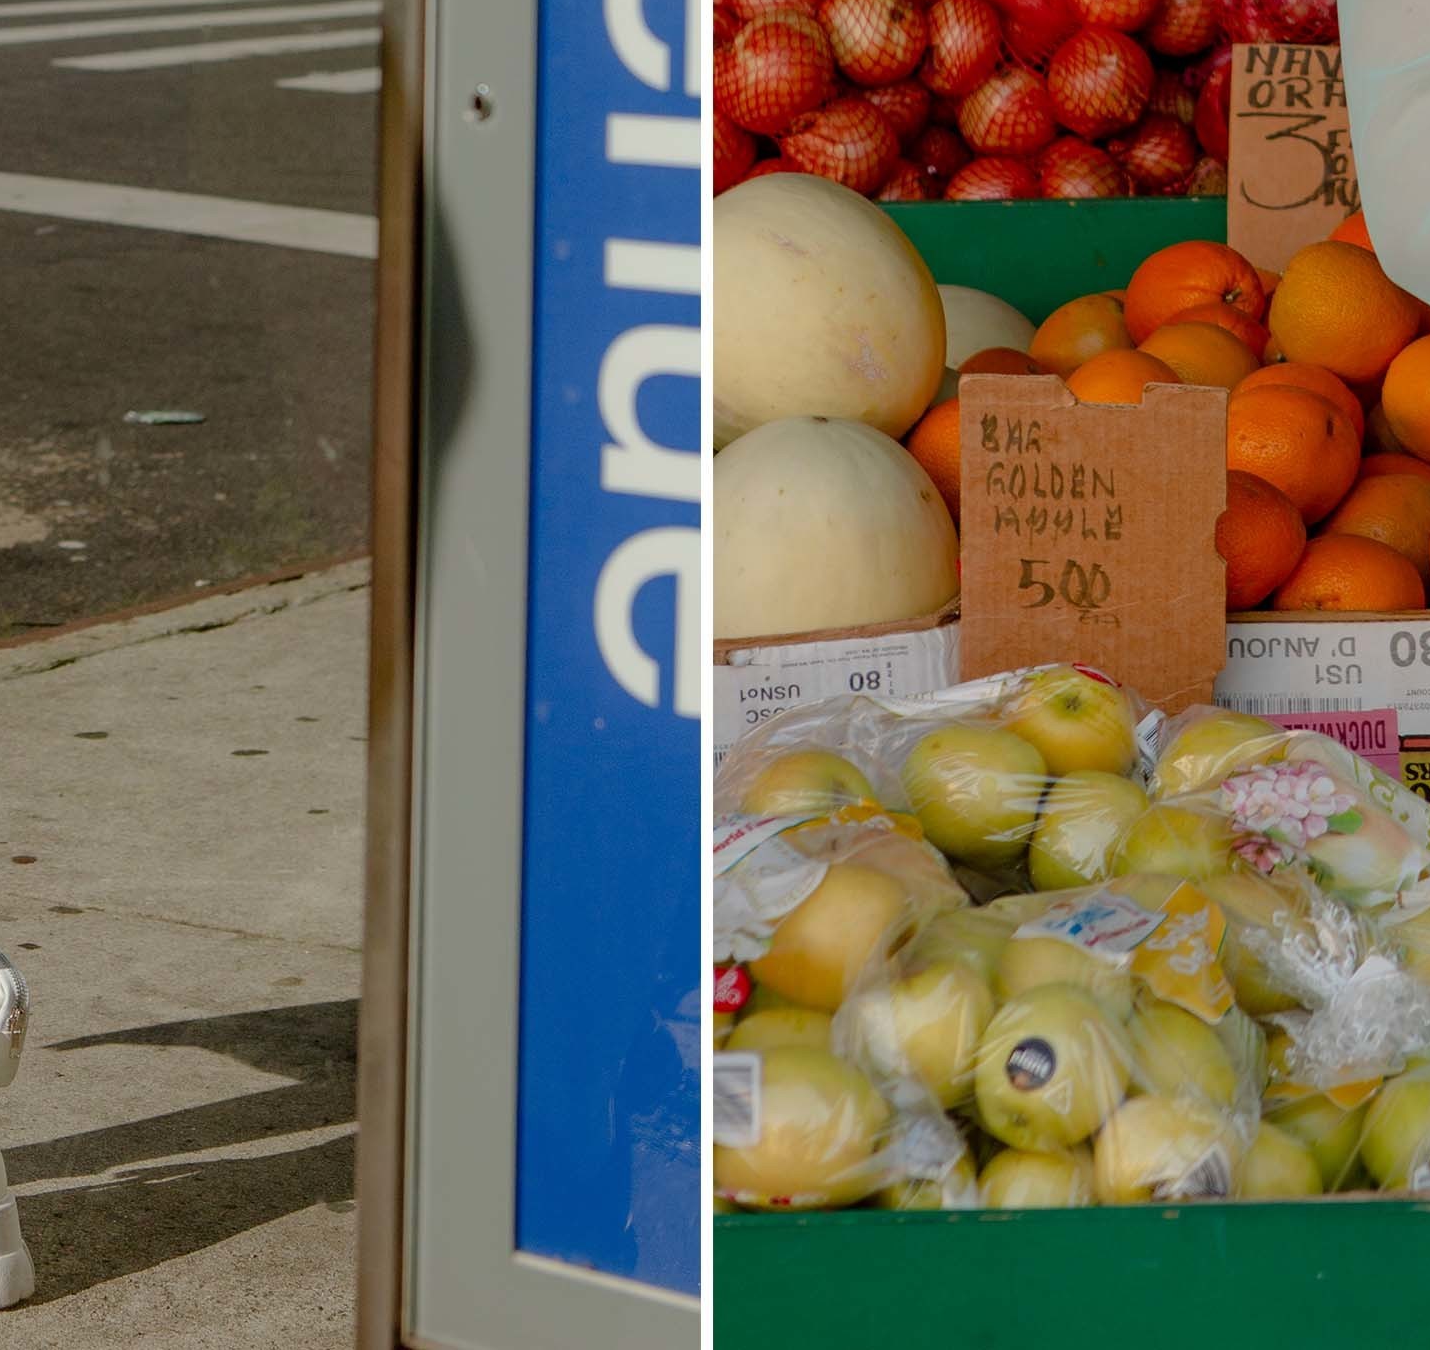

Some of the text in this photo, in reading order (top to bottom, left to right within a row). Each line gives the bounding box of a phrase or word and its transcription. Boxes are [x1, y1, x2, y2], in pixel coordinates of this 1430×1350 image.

[980, 413, 1042, 453] BAG
[986, 461, 1115, 500] GOLDEN
[994, 504, 1123, 544] APPLE
[1228, 636, 1319, 659] ANJOU
[849, 670, 881, 692] 80
[1315, 664, 1362, 684] US1
[1283, 719, 1386, 749] DUCKW
